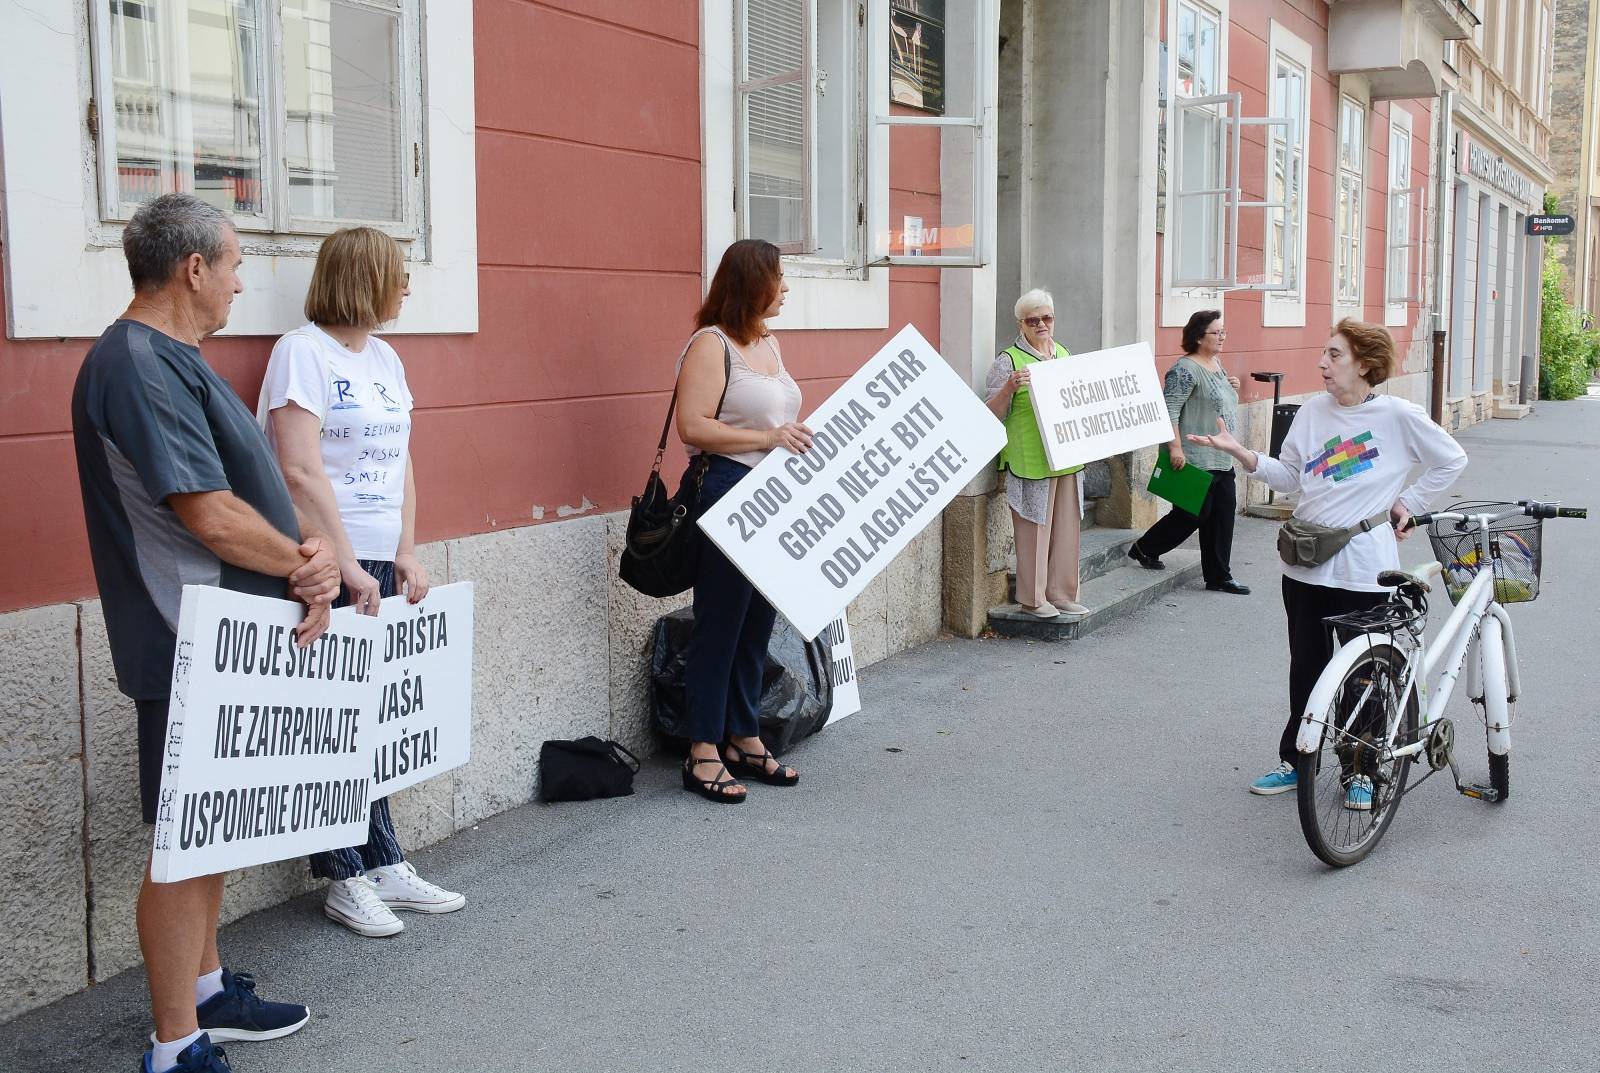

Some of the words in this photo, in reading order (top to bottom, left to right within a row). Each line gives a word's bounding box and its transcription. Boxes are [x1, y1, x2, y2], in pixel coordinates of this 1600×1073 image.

[1109, 369, 1141, 399] NEĆE
[329, 427, 351, 438] NE
[727, 475, 793, 543] 2000
[783, 398, 876, 486] GODINA
[865, 348, 927, 410] STAR
[1053, 419, 1081, 445] BITI
[778, 492, 846, 561] GRAD
[836, 437, 902, 504] NEĆE
[890, 396, 944, 451] BITI
[820, 439, 969, 589] ODLAGALIŠTE!
[214, 616, 258, 675] OVO
[259, 624, 285, 677] JE
[285, 627, 339, 681] SVETO
[340, 635, 374, 683] TLO!
[213, 704, 244, 759] NE
[245, 705, 360, 758] ZATRPAVAJTE
[179, 784, 290, 851] USPOMENE
[290, 777, 370, 834] OTPADOM!
